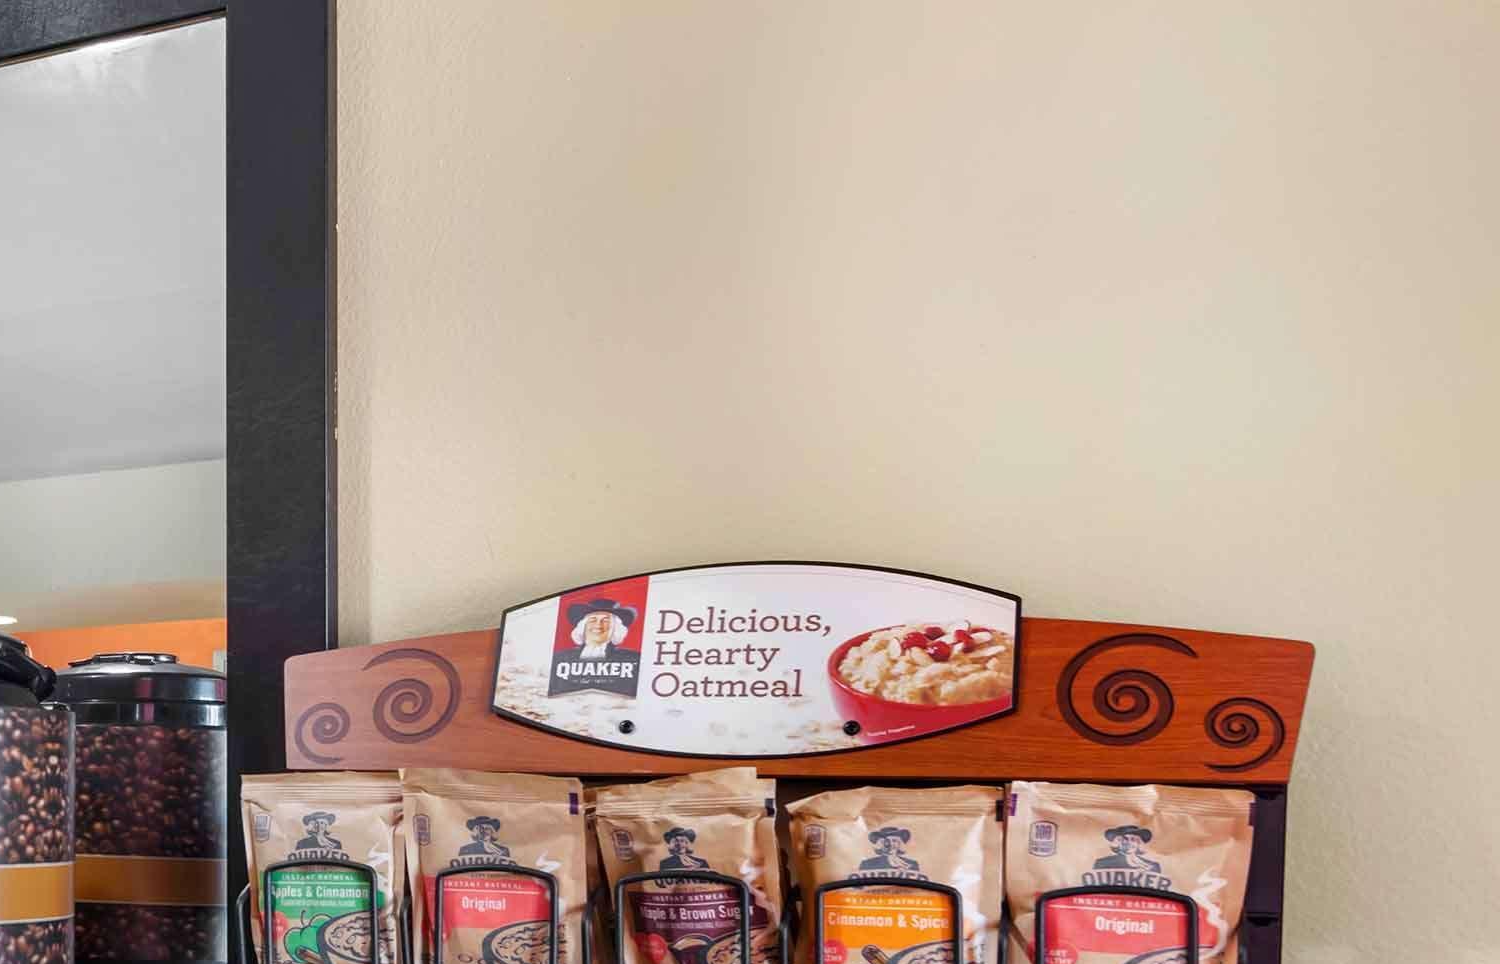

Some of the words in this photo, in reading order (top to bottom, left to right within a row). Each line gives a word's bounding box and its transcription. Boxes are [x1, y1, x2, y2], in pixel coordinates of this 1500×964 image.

[656, 606, 832, 637] Delicious,
[653, 641, 780, 671] Hearty
[556, 662, 634, 680] QUAKER
[651, 669, 803, 697] Oatmeal
[316, 886, 369, 898] Cinnamon
[461, 896, 506, 912] Original
[680, 907, 715, 919] Brown
[718, 905, 754, 920] Sugr
[828, 912, 893, 927] Cinnamon
[898, 913, 907, 928] &
[911, 914, 949, 930] Spice
[1095, 916, 1155, 935] Original
